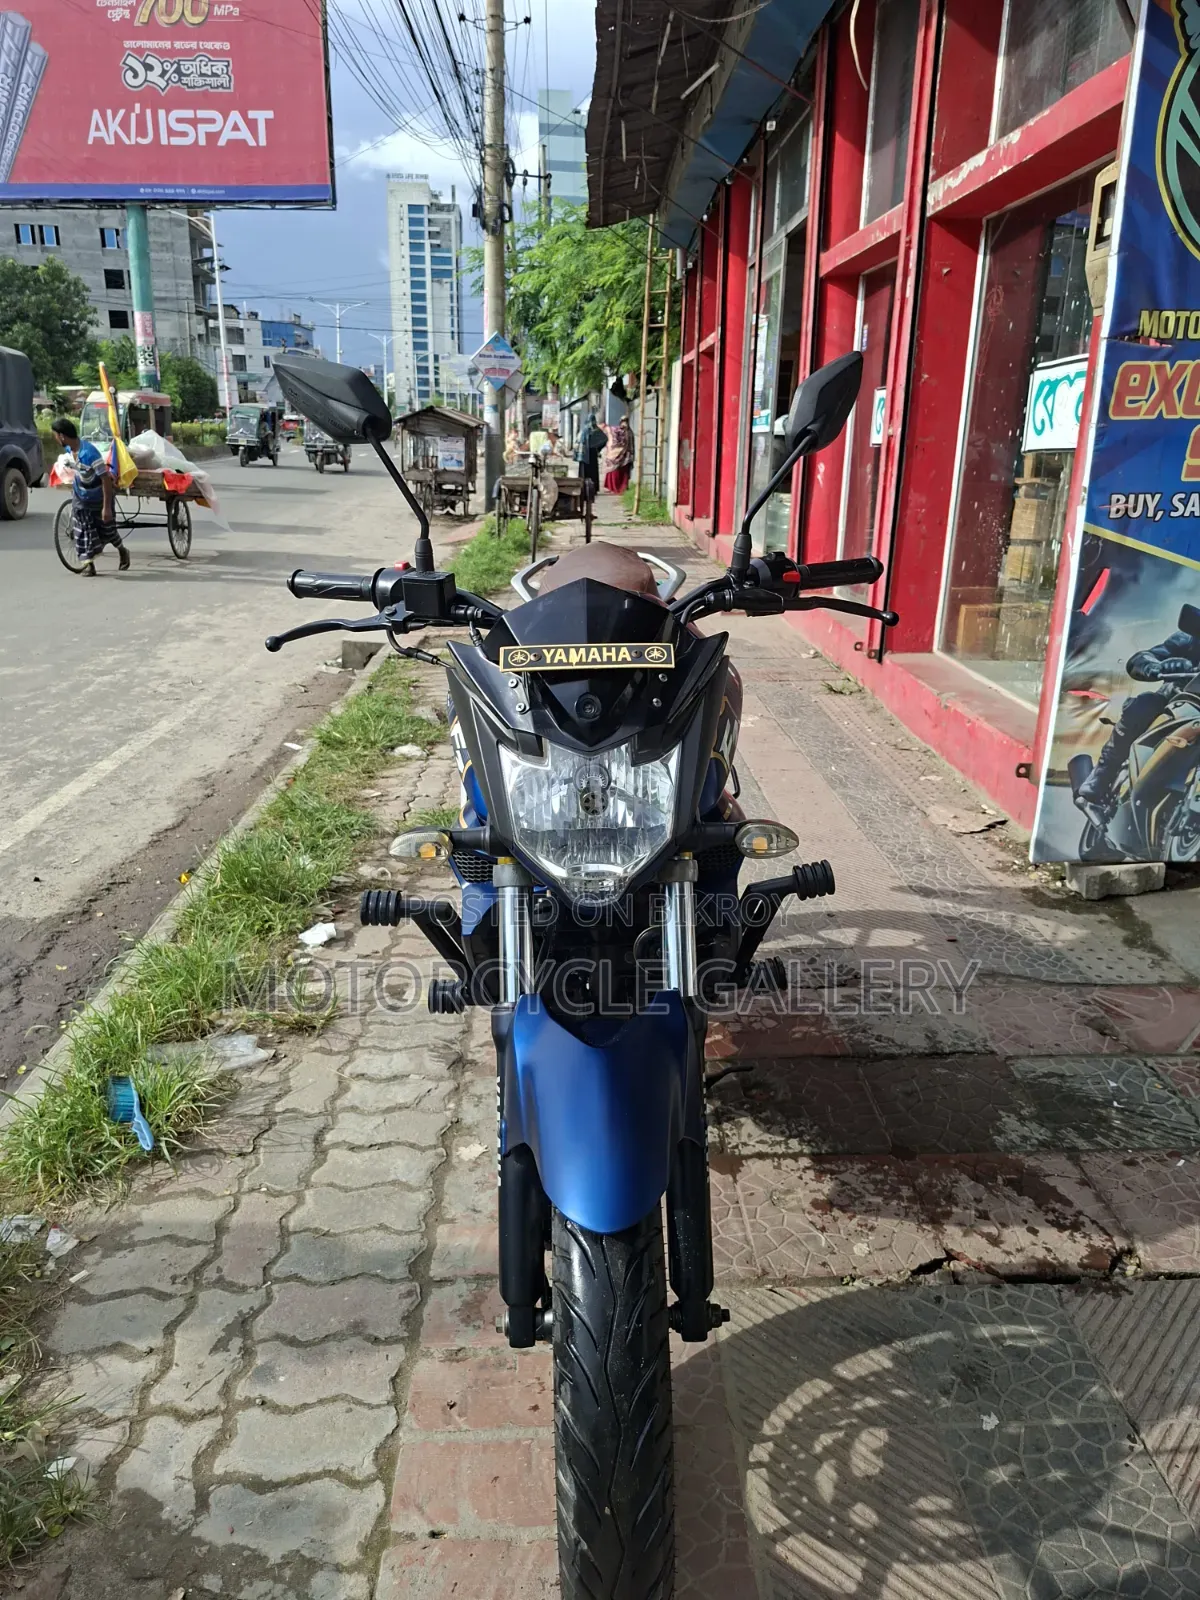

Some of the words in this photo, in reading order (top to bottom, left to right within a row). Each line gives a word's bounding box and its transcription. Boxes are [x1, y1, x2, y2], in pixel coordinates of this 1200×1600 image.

[213, 4, 240, 16] MPa
[123, 54, 179, 90] ১২%
[180, 55, 228, 76] অধিক
[157, 109, 275, 147] ISPAT
[1109, 494, 1163, 521] BUY,
[542, 647, 632, 665] YAMAHA
